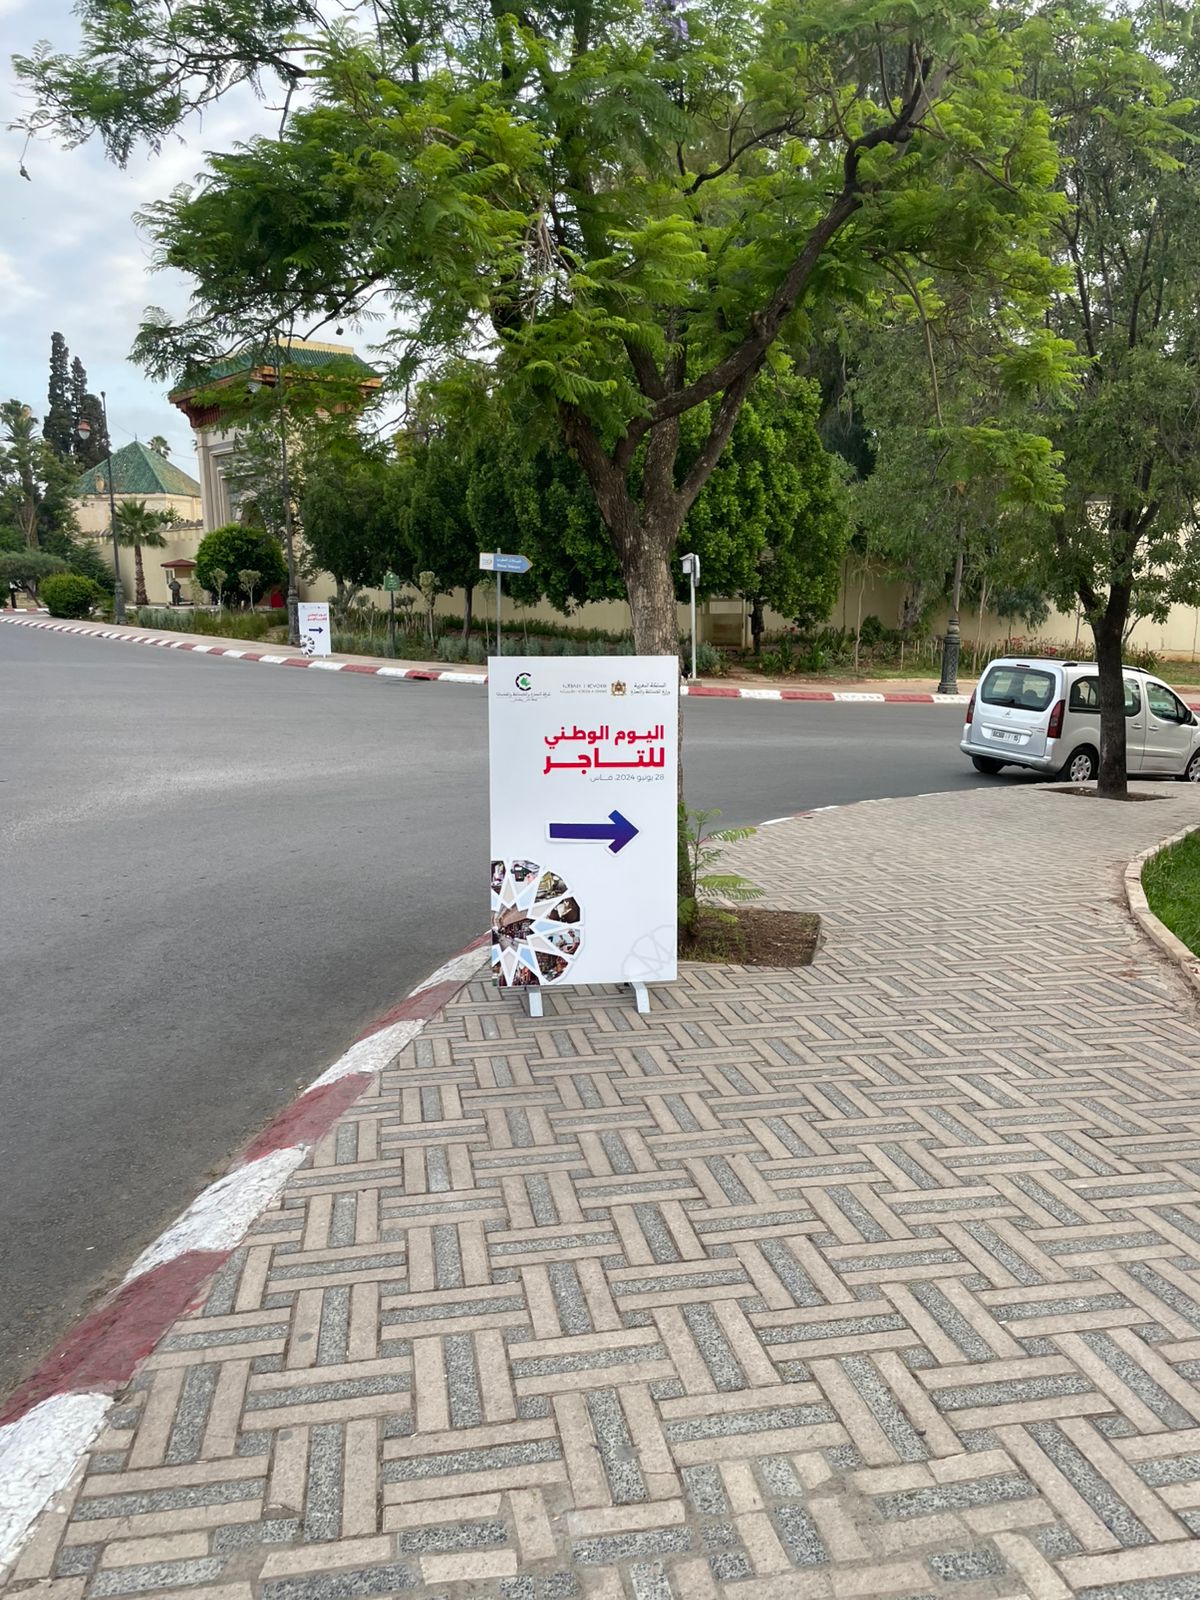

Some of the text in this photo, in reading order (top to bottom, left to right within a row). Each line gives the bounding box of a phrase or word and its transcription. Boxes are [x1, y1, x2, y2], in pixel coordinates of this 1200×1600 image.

[544, 725, 664, 750] اليوم الوطني
[543, 747, 665, 775] للتاجر
